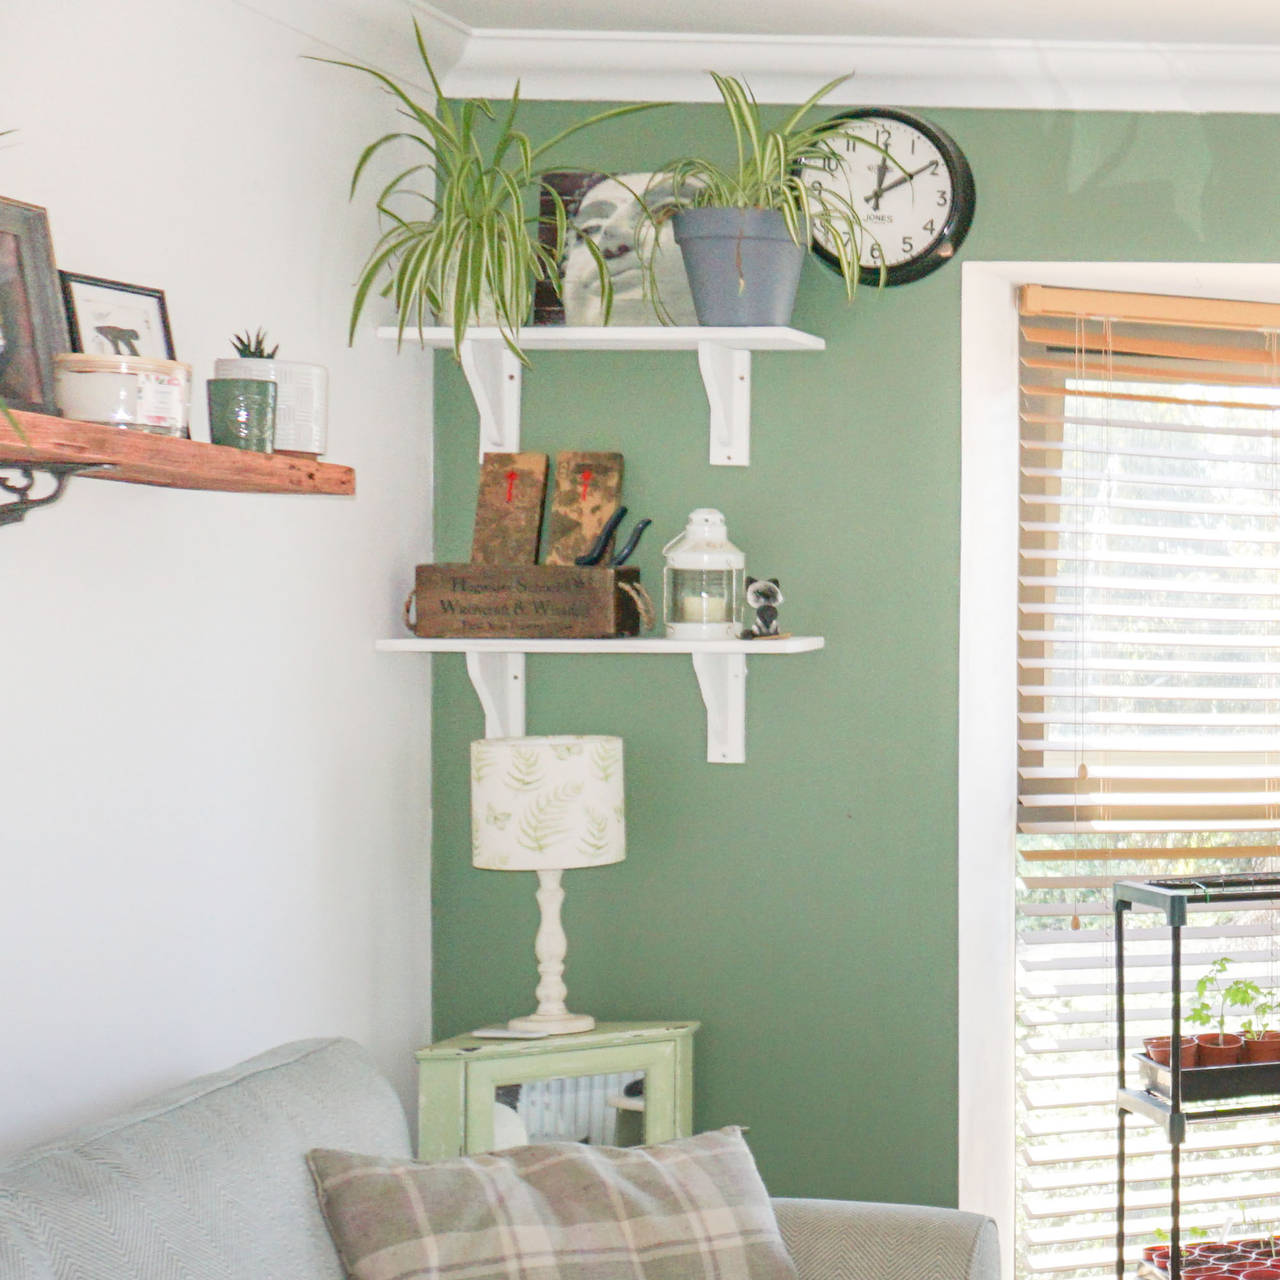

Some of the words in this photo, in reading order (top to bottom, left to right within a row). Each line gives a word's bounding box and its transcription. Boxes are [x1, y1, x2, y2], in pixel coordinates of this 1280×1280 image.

[876, 128, 891, 146] 12
[930, 160, 940, 175] 2
[811, 180, 823, 196] 9
[936, 190, 948, 207] 3
[922, 219, 935, 235] 4
[870, 243, 881, 258] 6
[902, 237, 914, 252] 5
